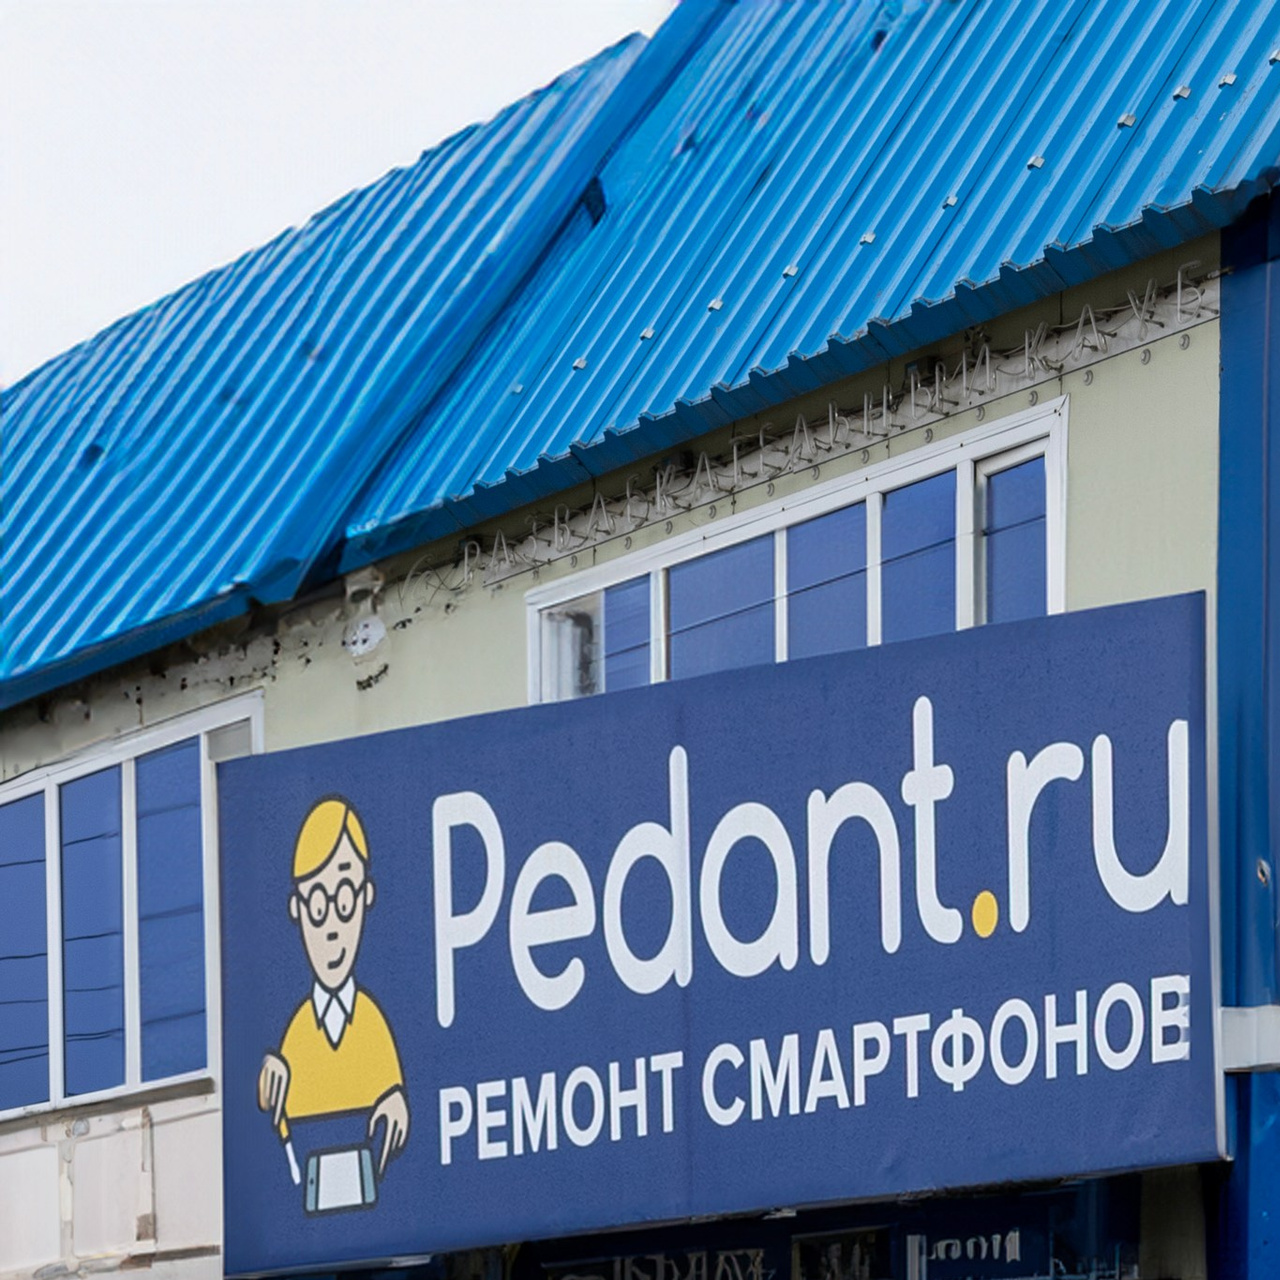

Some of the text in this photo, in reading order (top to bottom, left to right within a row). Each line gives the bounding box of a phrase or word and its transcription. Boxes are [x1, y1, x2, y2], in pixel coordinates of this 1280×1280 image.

[432, 695, 1190, 1028] Pedant.ru
[439, 974, 1190, 1166] РЕМОНТ СМАРТФОНОВ
